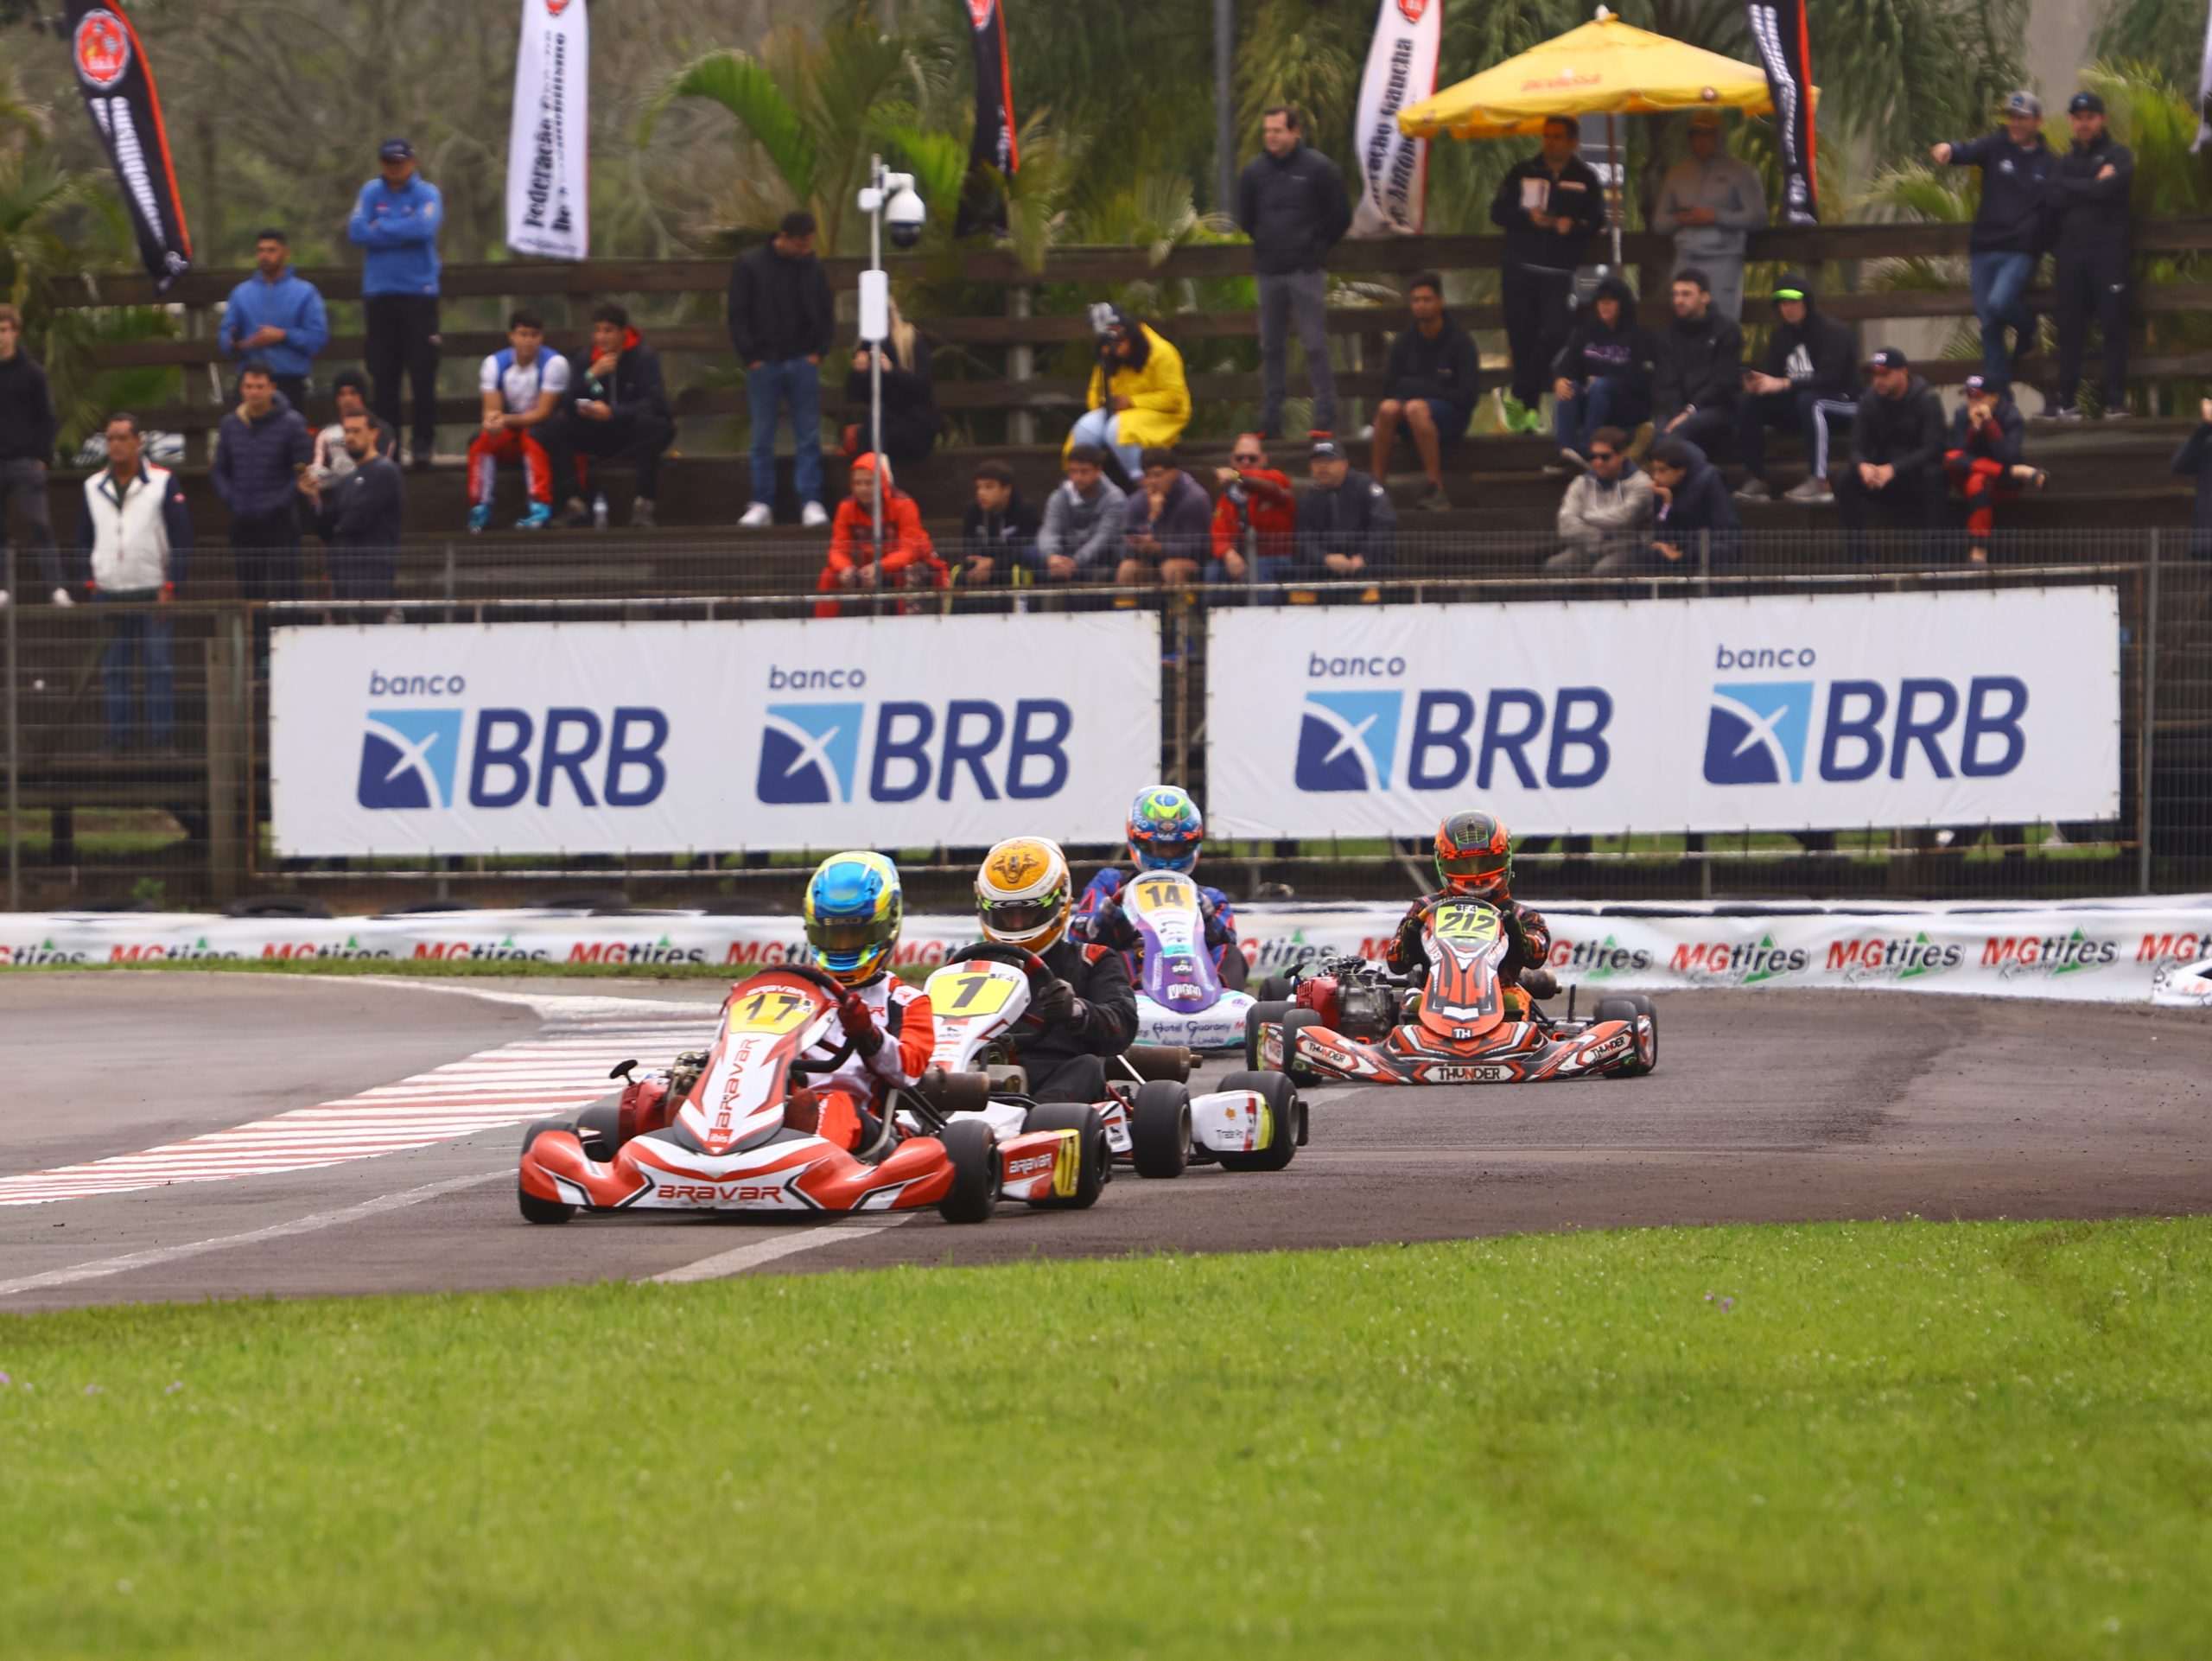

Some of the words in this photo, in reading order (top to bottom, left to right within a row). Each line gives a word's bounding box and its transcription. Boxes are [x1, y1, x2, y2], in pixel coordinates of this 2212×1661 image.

[1308, 652, 1407, 678] banco
[1715, 644, 1816, 670] banco
[369, 670, 467, 697] banco
[768, 665, 866, 690] banco
[1408, 686, 1613, 791] BRB
[1819, 675, 2030, 783] BRB
[468, 707, 670, 809] BRB
[869, 697, 1074, 803] BRB
[1146, 884, 1185, 907] 14
[1437, 912, 1497, 935] 212
[568, 941, 706, 965] MGtires
[1548, 939, 1653, 970] Gtires
[1668, 942, 1807, 974] MGtires
[1825, 938, 1964, 970] MGtires
[1980, 934, 2119, 965] MGtires
[951, 977, 989, 1009] 1
[746, 994, 802, 1022] 17
[1453, 1028, 1471, 1039] TH
[1308, 1042, 1347, 1063] THUNDER
[1589, 1036, 1625, 1060] THUNDER
[1438, 1066, 1500, 1080] THUNDER
